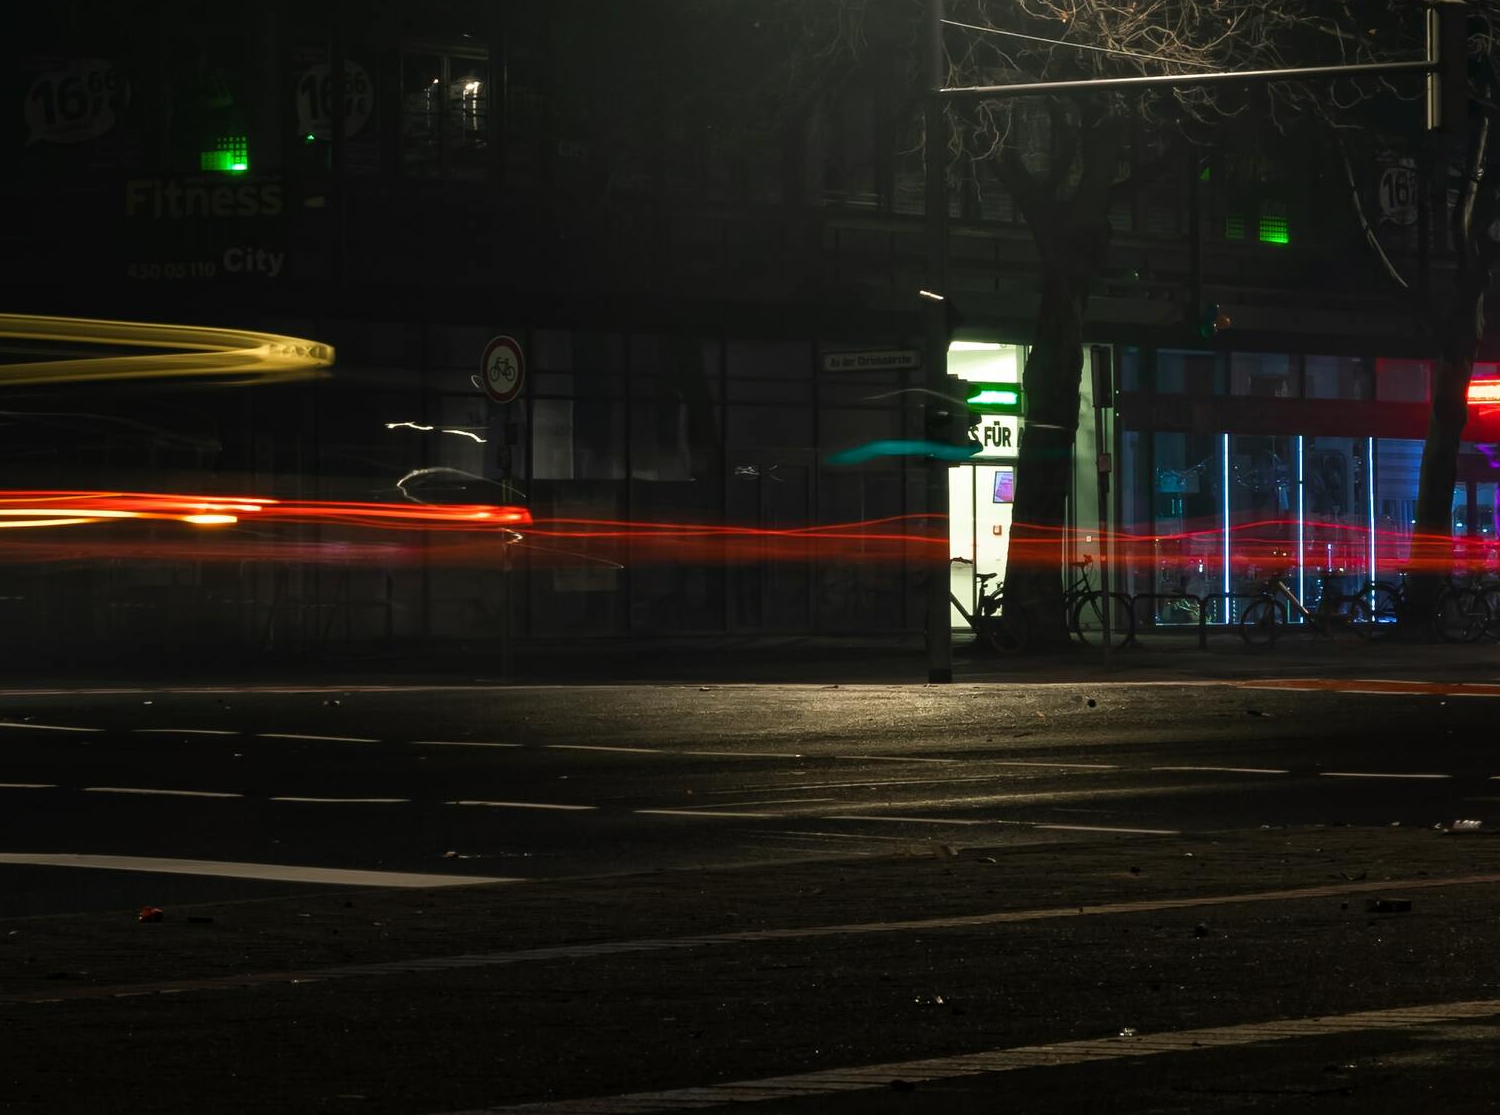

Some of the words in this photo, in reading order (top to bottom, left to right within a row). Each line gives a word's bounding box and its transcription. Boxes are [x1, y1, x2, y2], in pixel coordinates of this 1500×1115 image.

[125, 179, 284, 219] Fitness
[222, 246, 285, 278] City
[984, 420, 1012, 448] FÜR
